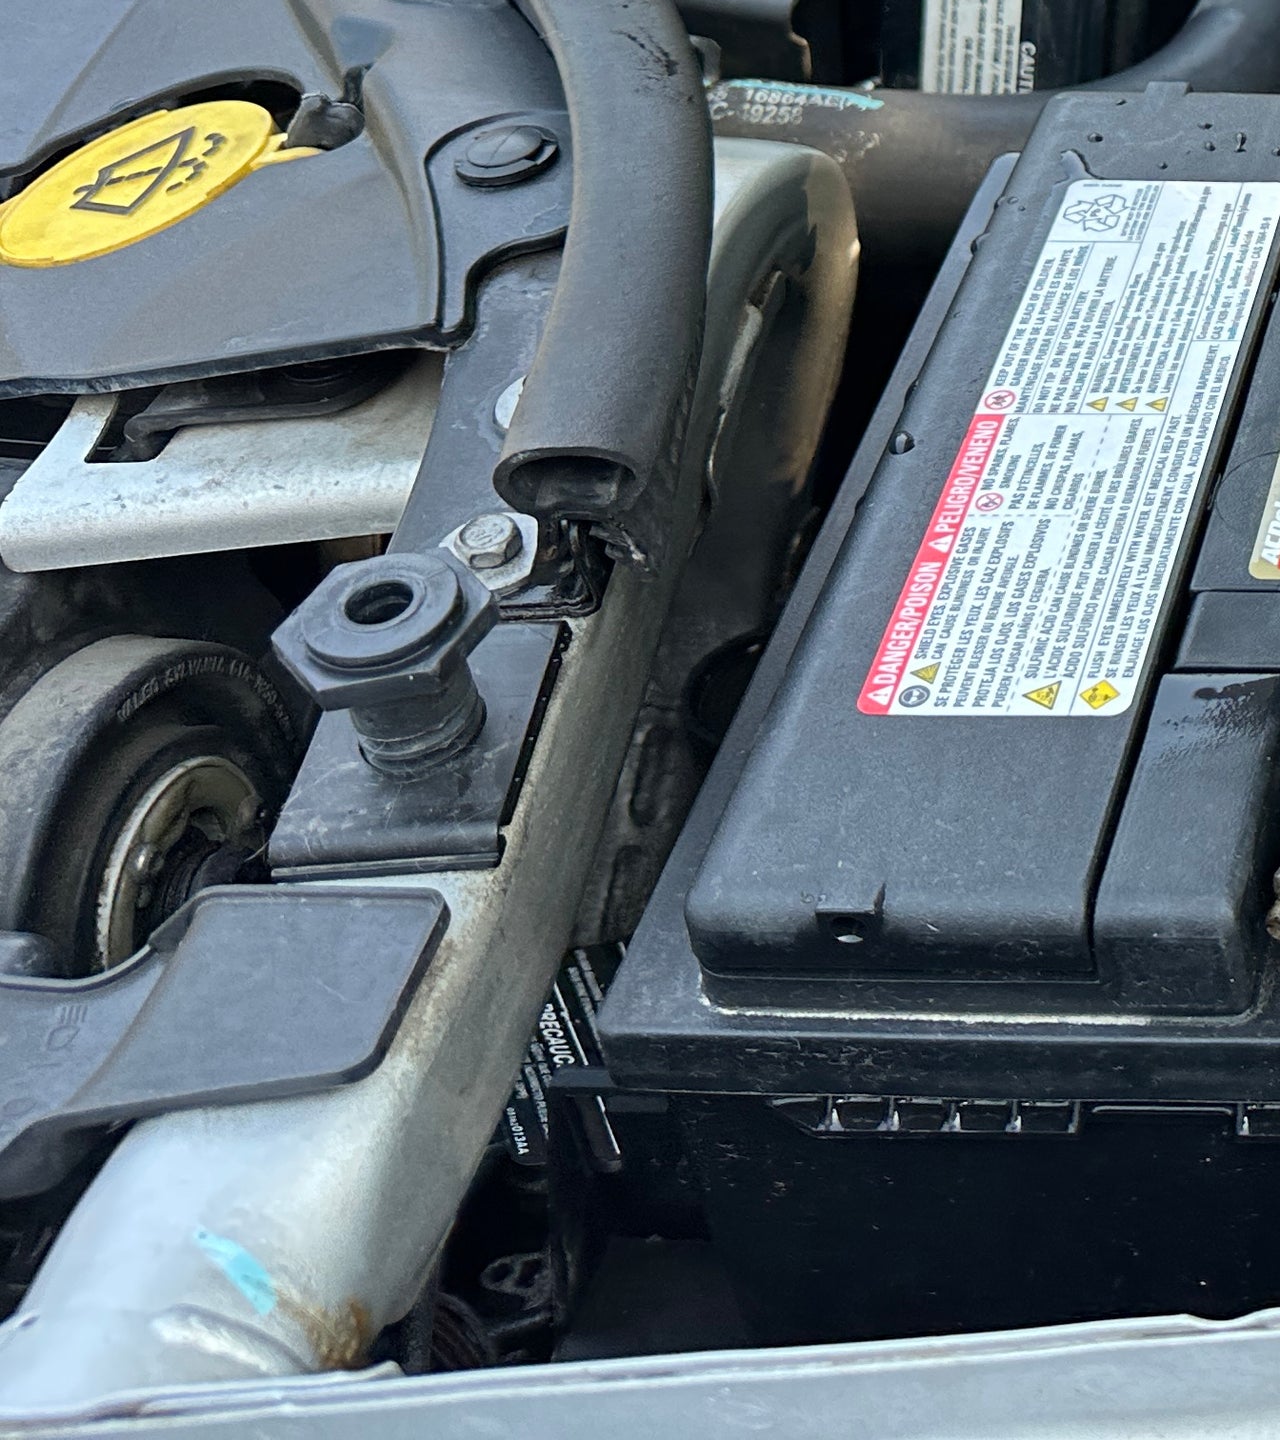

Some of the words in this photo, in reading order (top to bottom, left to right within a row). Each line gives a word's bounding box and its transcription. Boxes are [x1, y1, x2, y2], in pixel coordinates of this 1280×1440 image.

[998, 416, 1021, 445] FLAMES,
[1165, 413, 1182, 433] FAST.
[1048, 424, 1068, 449] FUMER
[1061, 430, 1085, 461] FLAMAS,
[1158, 434, 1176, 454] HELP
[985, 446, 1009, 476] SPARKS,
[1013, 441, 1045, 491] D'ÉTINCELLES,
[1044, 450, 1059, 459] DE
[979, 477, 997, 490] NO
[997, 454, 1022, 488] SMOKING
[1030, 460, 1054, 498] FLAMMES,
[1049, 462, 1072, 495] CHISPAS,
[1147, 455, 1169, 489] MEDICAL
[1102, 494, 1117, 504] OU
[1105, 479, 1122, 493] DES
[1142, 490, 1158, 506] GET
[1007, 492, 1026, 509] PAS
[1025, 499, 1040, 509] DE
[1043, 496, 1060, 509] NO
[1079, 494, 1099, 520] SEVERE
[1075, 521, 1090, 532] OR
[1091, 505, 1113, 529] CÉCITÉ
[954, 525, 977, 554] GASES
[970, 525, 992, 554] INJURY.
[986, 520, 1015, 564] EXPLOSIFS
[1021, 517, 1052, 569] EXPLOSIVOS
[1090, 530, 1105, 539] LA
[871, 561, 944, 684] DANGER/POISON
[932, 419, 999, 532] PELIGRO/VENENO
[966, 554, 981, 565] OR
[1079, 540, 1102, 569] CAUSER
[1123, 540, 1142, 562] WITH
[936, 555, 966, 600] EXPLOSIVE
[979, 565, 998, 583] GAZ
[995, 553, 1020, 588] AVEUGLE.
[1052, 570, 1073, 595] CAUSE
[1073, 570, 1092, 589] PEUT
[948, 568, 976, 611] BLINDNESS
[972, 585, 991, 601] LES
[1010, 570, 1033, 599] GASES
[1027, 566, 1052, 603] CEGUERA.
[1087, 576, 1108, 600] PUEDE
[1104, 563, 1135, 622] IMMEDIATELY
[926, 601, 948, 626] EYES.
[963, 602, 985, 627] YEUX.
[984, 590, 1007, 620] RENDRE
[1003, 600, 1022, 618] LOS
[1046, 596, 1064, 612] CAN
[1054, 590, 1085, 643] SULFURIQUE
[938, 612, 959, 638] CAUSE
[956, 628, 975, 645] LES
[979, 621, 995, 633] OU
[993, 619, 1016, 645] OJOS.
[1012, 611, 1036, 639] DAÑOS
[1038, 613, 1058, 635] ACID
[1096, 624, 1116, 646] EYES
[913, 628, 938, 659] SHIELD
[930, 642, 948, 659] CAN
[966, 634, 991, 669] BLESSER
[986, 646, 1006, 664] LOS
[1002, 640, 1026, 673] CAUSAR
[935, 646, 969, 693] PROTÉGER
[1023, 636, 1051, 678] SULFURIC
[1042, 644, 1067, 678] L'ACIDE
[1086, 650, 1107, 678] FLUSH
[951, 670, 977, 707] PEUVENT
[971, 665, 999, 707] PROTEJA
[990, 674, 1014, 707] PUEDEN
[932, 695, 951, 707] SE
